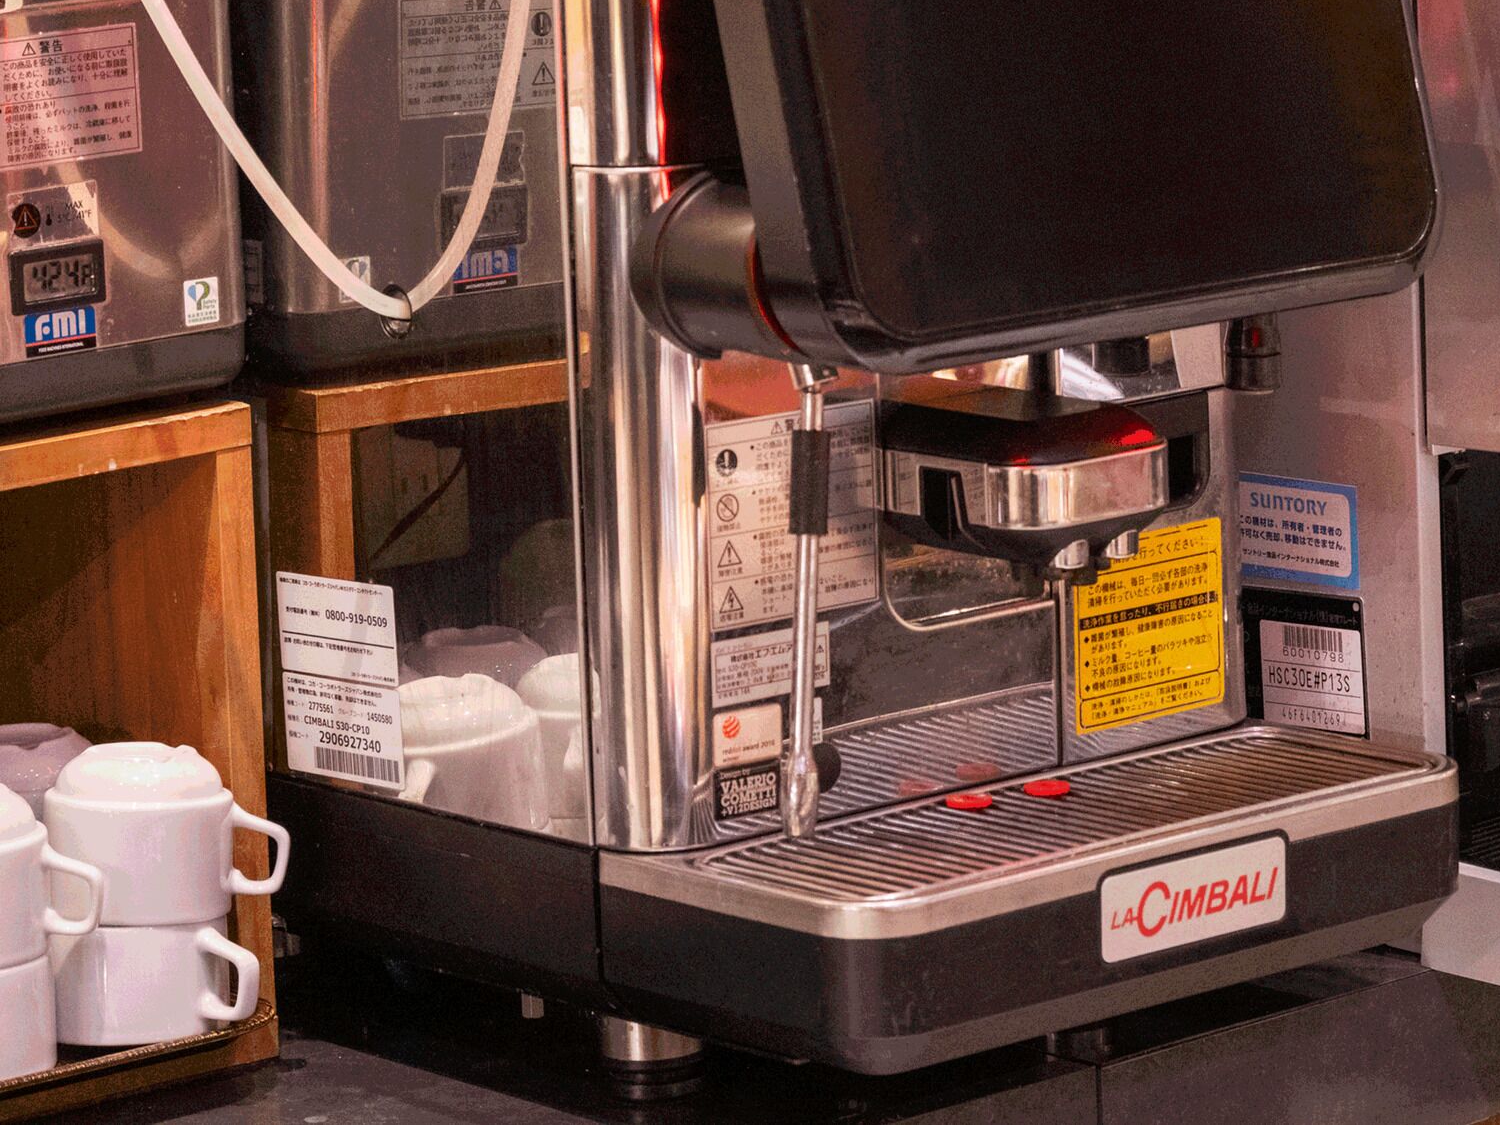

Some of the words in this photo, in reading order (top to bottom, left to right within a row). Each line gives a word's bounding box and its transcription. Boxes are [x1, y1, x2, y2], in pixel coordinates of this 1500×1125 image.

[39, 39, 63, 53] 警告
[2, 48, 127, 71] この商品を安全に正しく使用していた
[3, 58, 128, 81] だくために、お使いになる前に取扱説
[3, 68, 128, 92] 明書をよくお読みになり、十分に理解
[65, 200, 83, 210] MAX
[1250, 491, 1328, 516] SUNTORY
[1242, 548, 1340, 568] サントリー食品インターナショナル株式会社
[325, 609, 387, 628] 0800-919-0509
[1282, 646, 1344, 664] 60010798
[1268, 665, 1350, 693] HSC30E#P13S
[308, 701, 334, 714] 2775561
[367, 712, 393, 725] 1450580
[304, 715, 334, 729] CIMBALI
[336, 721, 370, 735] S30-CP10
[319, 730, 381, 753] 2906927340
[742, 742, 760, 751] award
[720, 773, 776, 794] VALERIO
[720, 785, 776, 807] COMETTI
[721, 797, 776, 817] +V12DESIGN
[1136, 867, 1278, 937] CIMBALI
